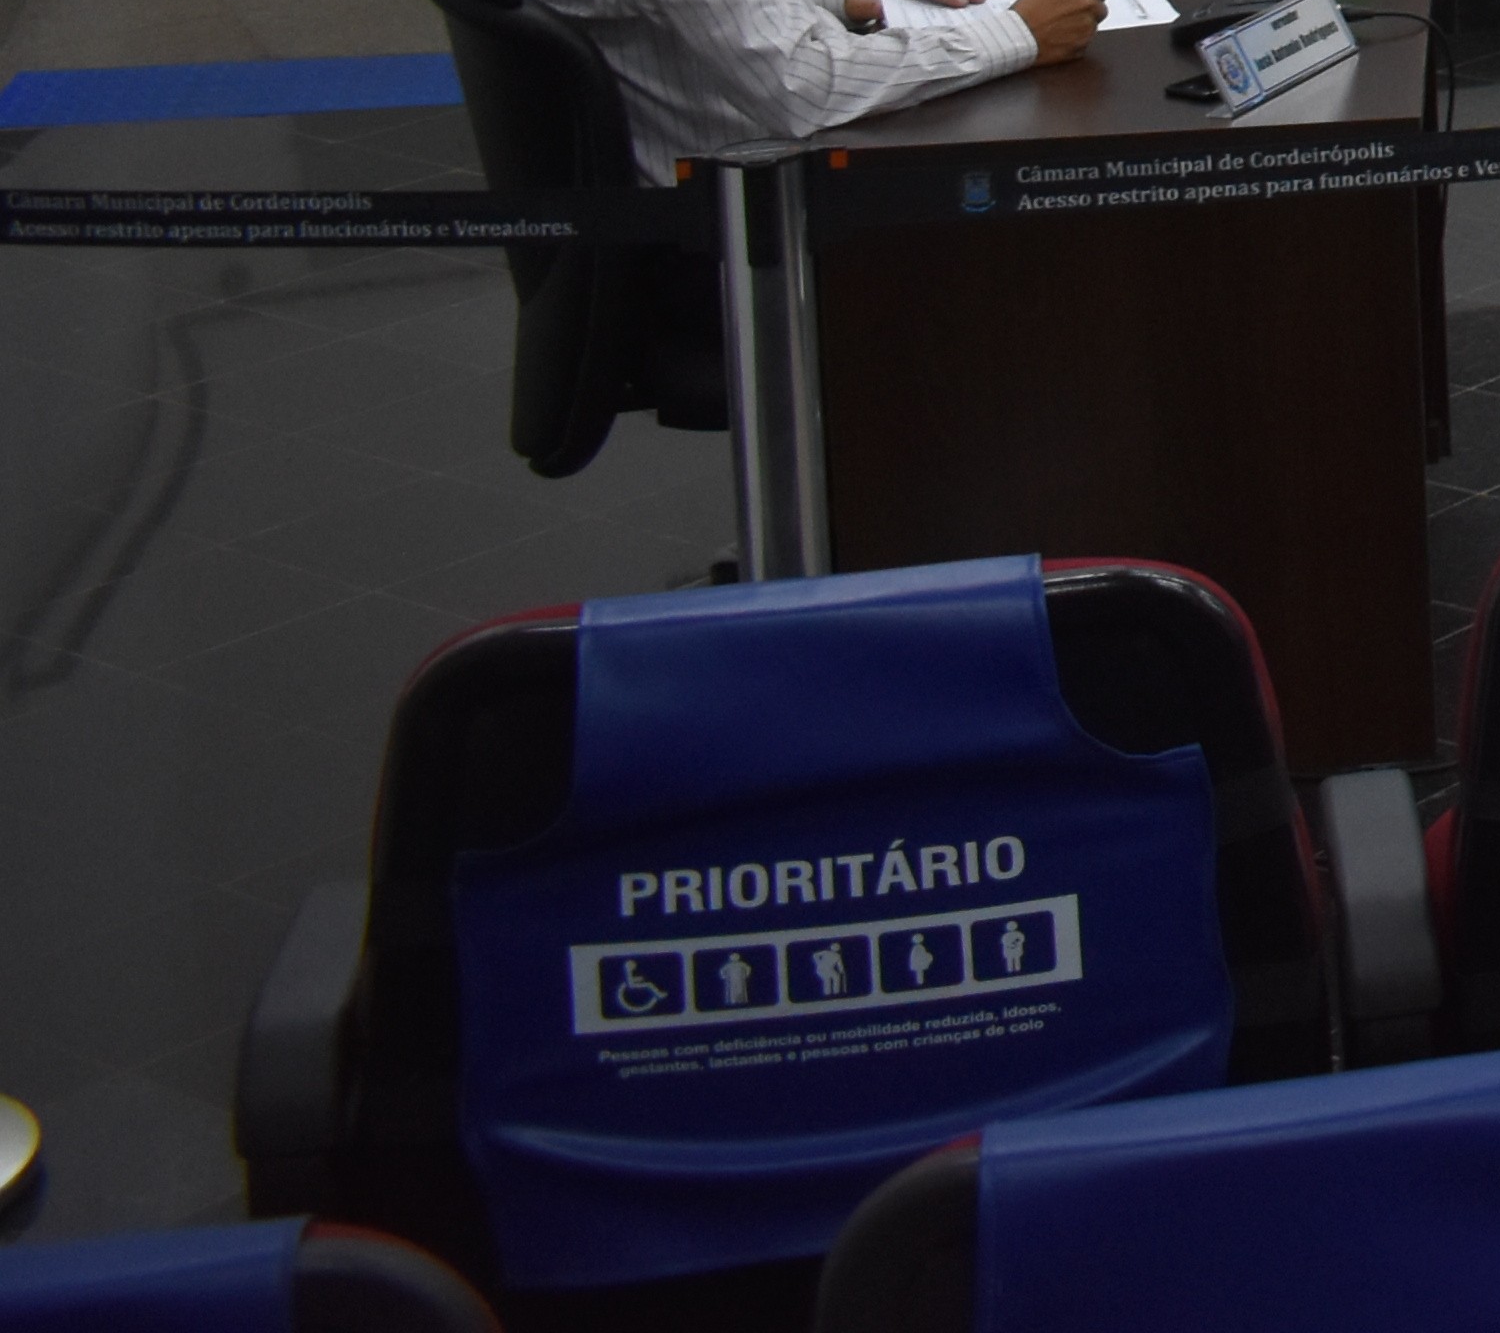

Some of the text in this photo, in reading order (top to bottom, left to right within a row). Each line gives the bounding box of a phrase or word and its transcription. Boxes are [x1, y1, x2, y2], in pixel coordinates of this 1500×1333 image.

[1016, 141, 1396, 184] Câmara Municipal de Cordeirópolis
[6, 191, 373, 216] Câmara Municipal de Cordeirópolis
[1017, 192, 1092, 212] Acesso
[1096, 184, 1180, 207] restrito
[1184, 183, 1260, 203] apenas
[1265, 176, 1314, 199] para
[1318, 163, 1453, 191] funcionários
[1457, 165, 1470, 178] e
[9, 218, 579, 243] Acesso restrito apenas para funcionários e Vereadores.
[618, 834, 1026, 917] PRIORITÁRIO
[599, 1001, 1063, 1063] Pessoas com deficiência ou mobilidade reduzida, idosos,
[619, 1019, 1045, 1079] gestantes, lactantes e pessoas com crianças de colo
